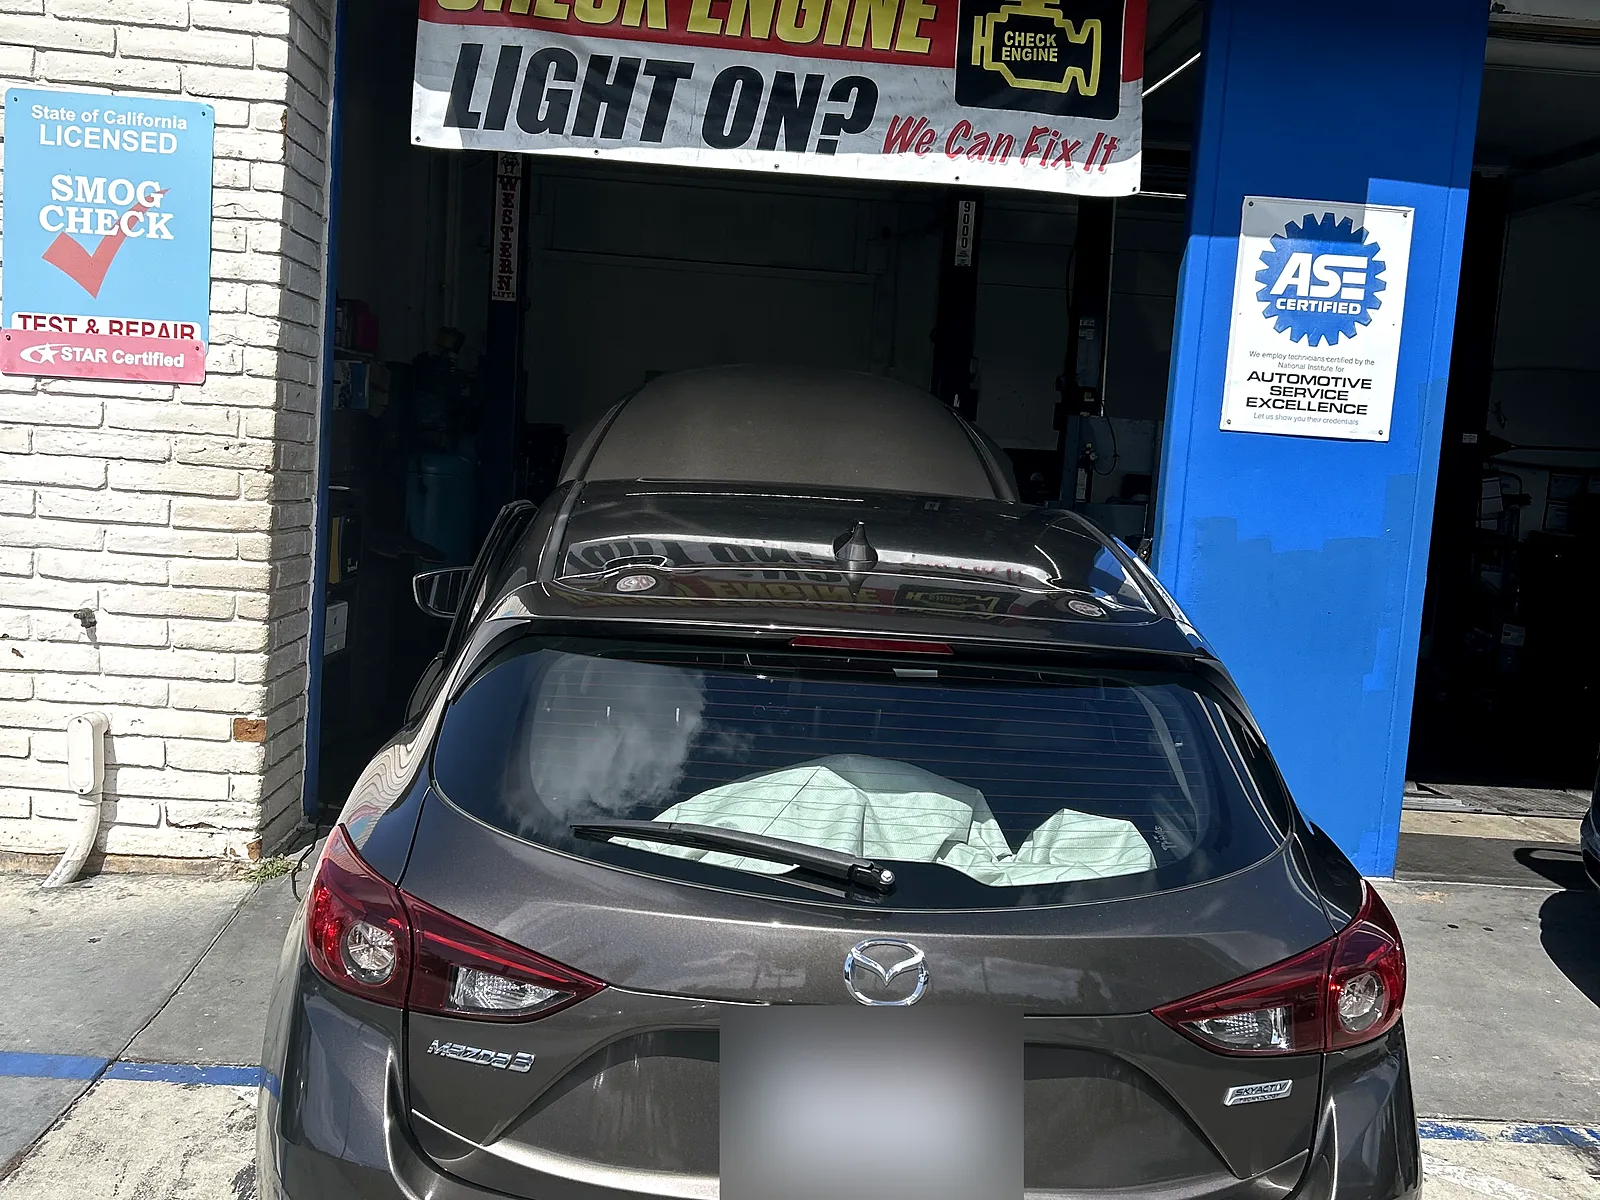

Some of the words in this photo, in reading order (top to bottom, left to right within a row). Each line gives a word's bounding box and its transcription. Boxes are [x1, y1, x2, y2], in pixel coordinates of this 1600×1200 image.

[1004, 30, 1057, 47] CHECK
[1001, 47, 1058, 62] ENGINE
[443, 43, 696, 143] LIGHT
[701, 66, 879, 156] ON?
[31, 104, 76, 121] State
[81, 109, 100, 123] of
[103, 110, 187, 130] California
[39, 124, 178, 155] LICENSED
[883, 114, 936, 157] We
[945, 119, 1016, 163] Can
[1019, 125, 1081, 169] Fix
[1083, 132, 1118, 172] It
[51, 174, 164, 208] SMOG
[39, 205, 175, 240] CHECK
[497, 174, 521, 291] WESTERN
[961, 201, 971, 248] 9000
[1269, 252, 1368, 300] ASE
[1276, 298, 1362, 315] CERTIFIED
[18, 314, 78, 333] TEST
[85, 319, 100, 334] &
[109, 320, 195, 340] REPAIR
[60, 347, 108, 363] STAR
[111, 351, 185, 368] Certified
[1249, 350, 1260, 358] We
[1262, 352, 1287, 361] employ
[1287, 353, 1325, 362] technicians
[1326, 356, 1353, 365] certified
[1354, 358, 1364, 366] by
[1278, 362, 1306, 370] National
[1307, 362, 1333, 372] Institute
[1335, 365, 1345, 373] for
[1246, 371, 1373, 389] AUTOMOTIVE
[1269, 385, 1349, 401] SERVICE
[1246, 397, 1368, 415] EXCELLENCE
[1275, 413, 1292, 421] show
[1293, 415, 1306, 423] you
[1322, 417, 1359, 425] credentials
[1235, 1083, 1287, 1096] SKYACTIV
